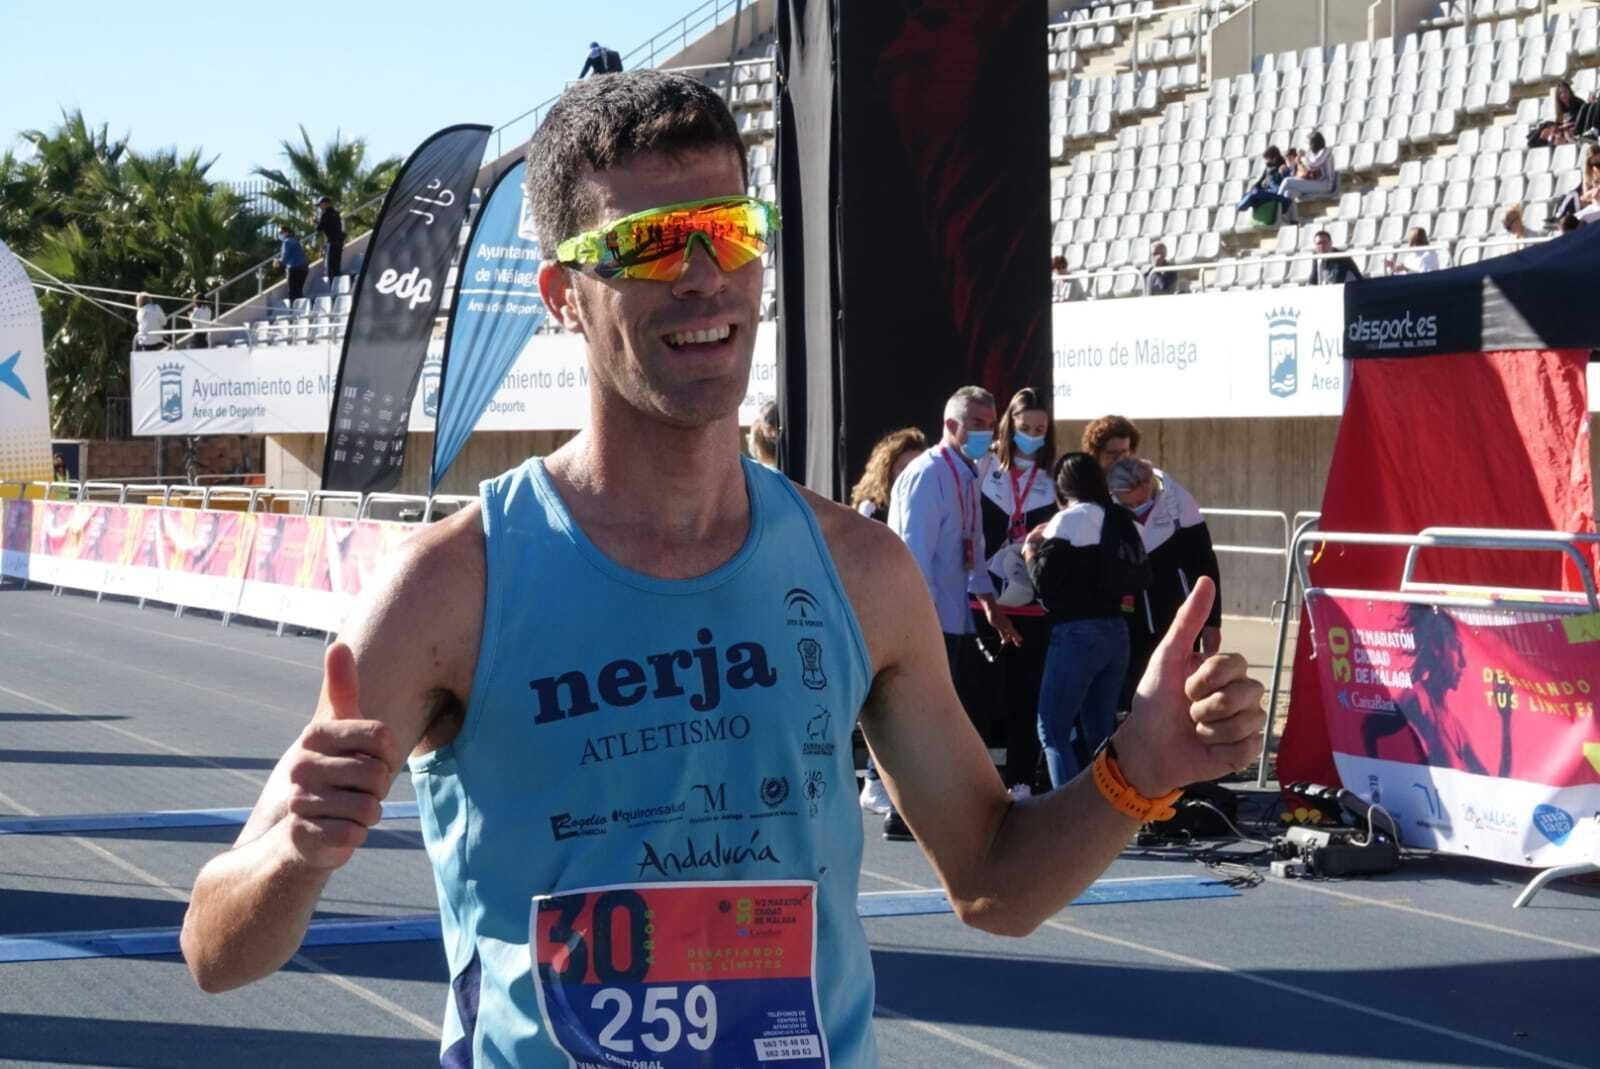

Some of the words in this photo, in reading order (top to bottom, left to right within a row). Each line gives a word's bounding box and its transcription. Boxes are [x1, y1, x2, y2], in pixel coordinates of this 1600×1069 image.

[477, 244, 542, 261] Ayuntami
[475, 268, 490, 282] de
[375, 267, 432, 310] edp
[1053, 344, 1103, 368] miento
[1109, 341, 1129, 366] de
[1135, 336, 1198, 370] Málaga
[192, 376, 291, 398] Ayuntamiento
[297, 377, 313, 394] de
[502, 368, 552, 390] miento
[557, 368, 574, 388] de
[216, 406, 227, 416] de
[229, 404, 266, 418] Deporte
[489, 400, 526, 415] Deporte
[529, 627, 777, 725] nerja
[1355, 668, 1369, 684] DE
[1485, 691, 1519, 709] TUS
[578, 714, 751, 766] ATLETISMO
[636, 827, 780, 878] Andalucía
[538, 889, 649, 984] 30
[591, 984, 718, 1053] 259
